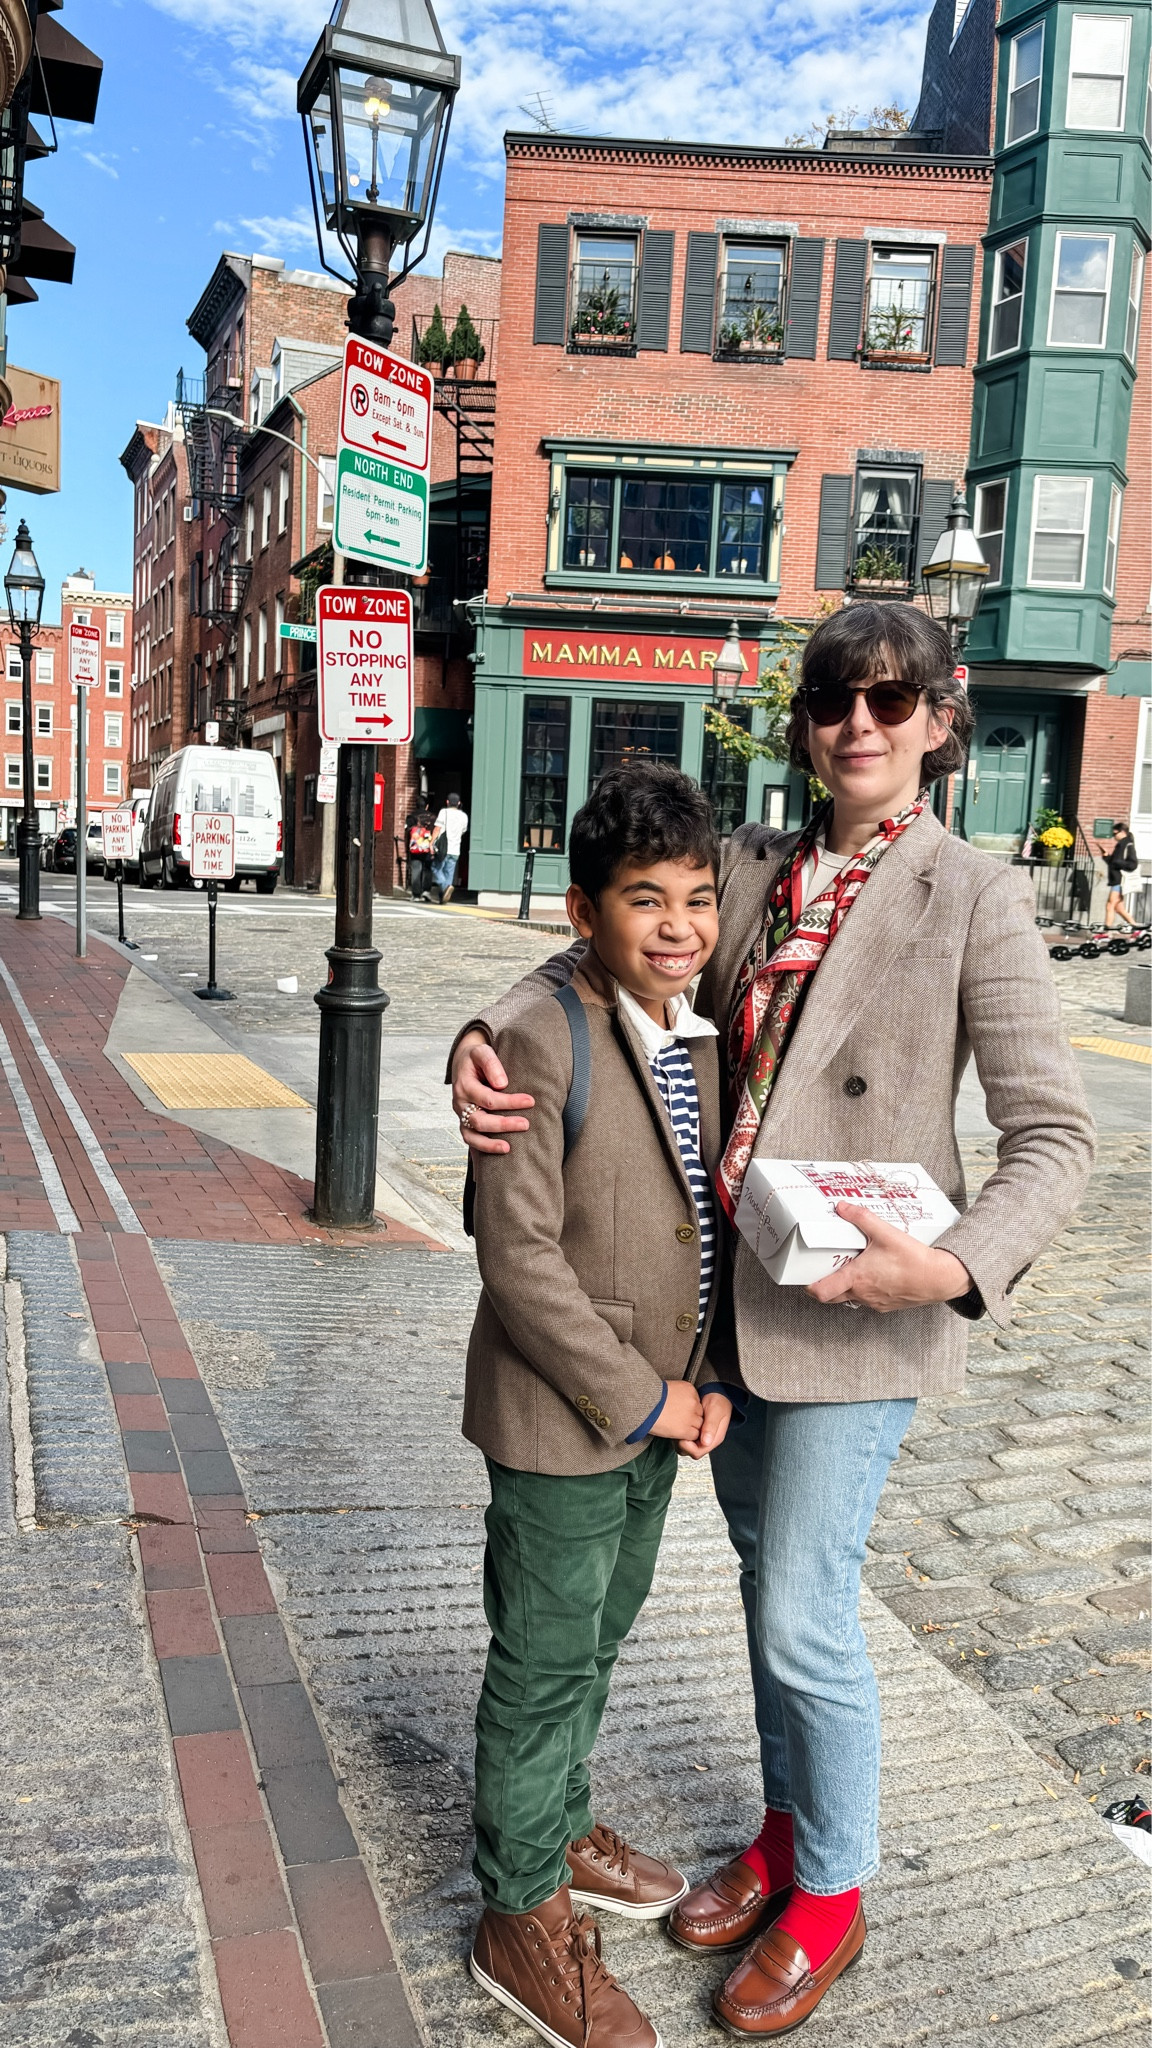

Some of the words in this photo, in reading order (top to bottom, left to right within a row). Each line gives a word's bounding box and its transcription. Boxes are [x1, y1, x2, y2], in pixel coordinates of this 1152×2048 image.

[356, 346, 384, 373] TOW
[389, 363, 424, 392] ZONE
[372, 408, 392, 426] Except
[405, 422, 411, 433] &
[13, 453, 53, 474] LIQUORS
[354, 456, 389, 482] NORTH
[393, 469, 414, 490] END
[342, 485, 371, 503] Resident
[373, 495, 395, 510] Permit
[397, 502, 422, 522] Parking
[323, 595, 357, 615] TOW
[364, 597, 407, 617] ZONE
[72, 627, 83, 635] TOW
[84, 628, 99, 639] ZONE
[289, 626, 317, 640] PRINCE
[349, 629, 382, 649] NO
[72, 647, 98, 658] STOPPING
[530, 641, 643, 668] MAMMA
[652, 648, 750, 672] MAR
[79, 657, 91, 665] ANY
[325, 651, 407, 669] STOPPING
[79, 666, 91, 674] TIME
[350, 672, 383, 687] ANY
[348, 692, 387, 707] TIME
[111, 814, 122, 823] NO
[205, 818, 221, 831] NO
[105, 825, 130, 834] PARKING
[111, 836, 125, 844] ANY
[195, 832, 231, 845] PARKING
[111, 845, 126, 853] TIME
[204, 849, 222, 858] ANY
[203, 860, 224, 871] TIME
[764, 1215, 780, 1245] Pastry
